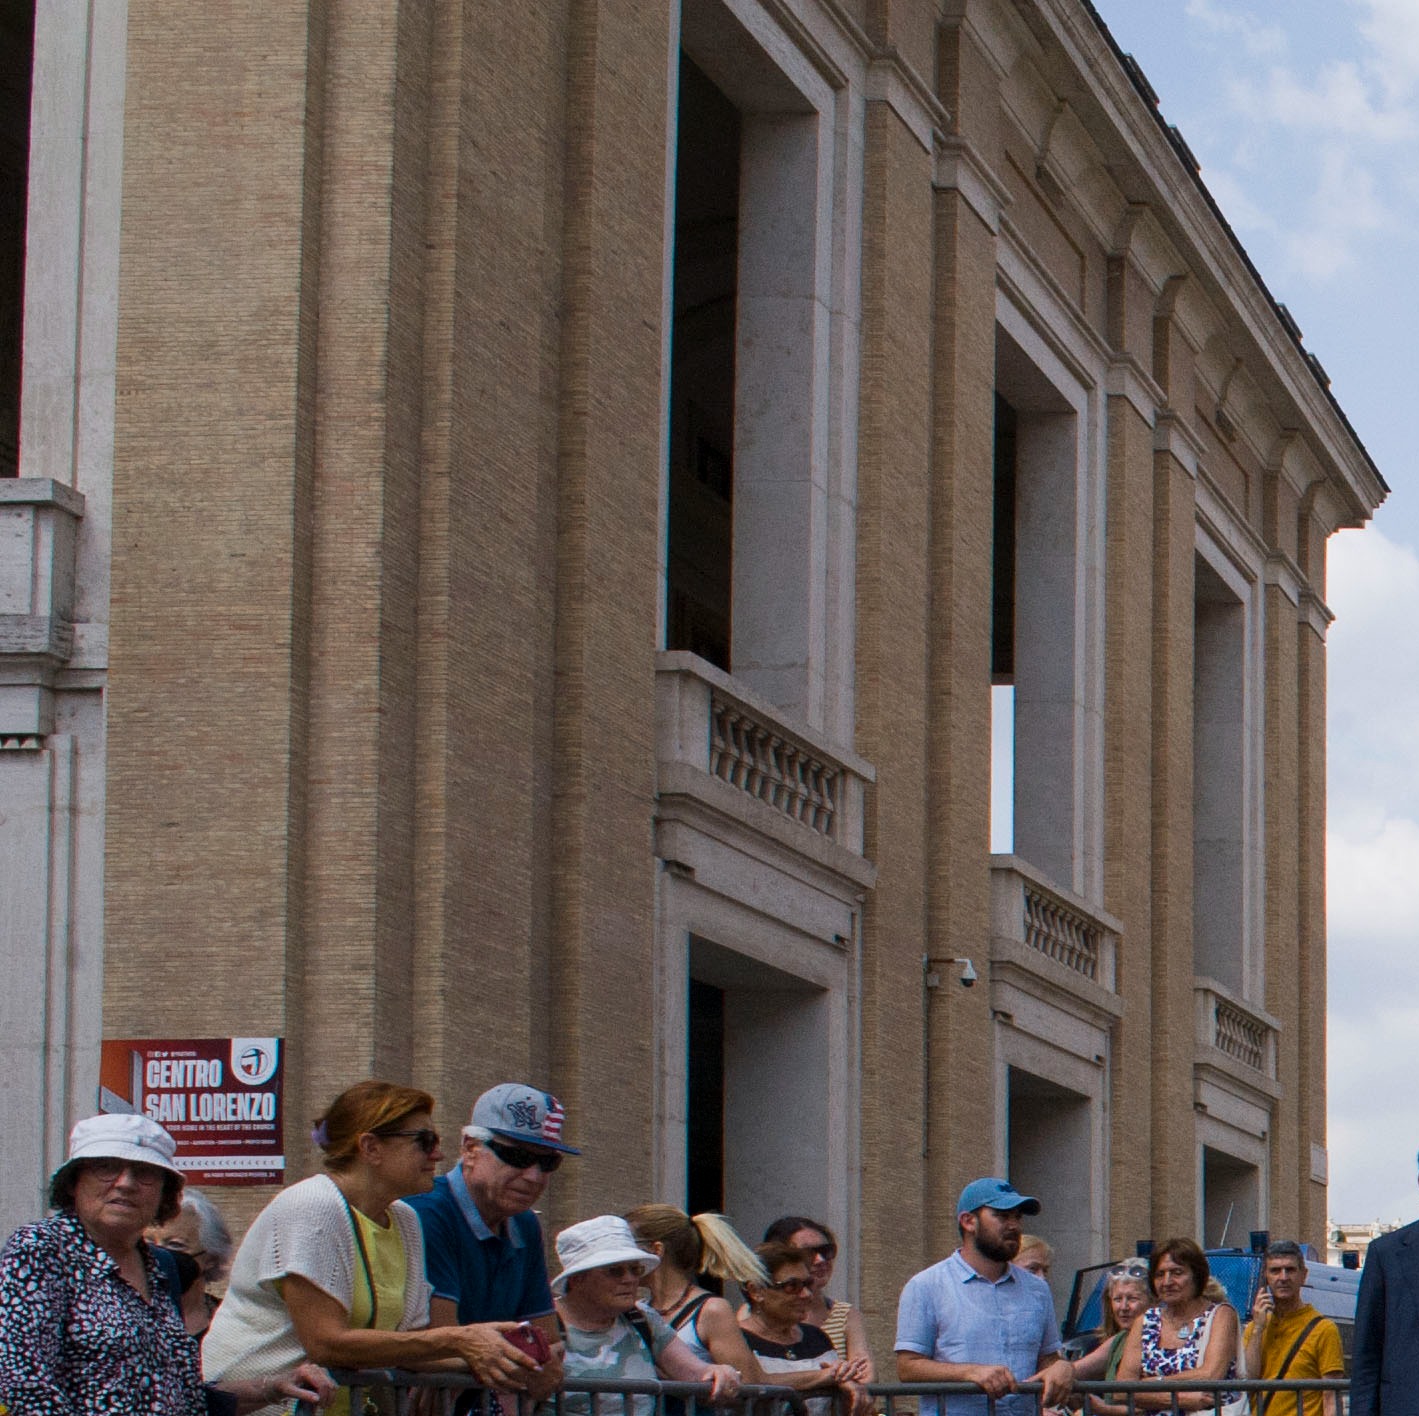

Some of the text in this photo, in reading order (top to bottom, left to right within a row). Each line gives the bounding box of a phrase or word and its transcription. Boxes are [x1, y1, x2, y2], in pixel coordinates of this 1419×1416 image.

[146, 1059, 222, 1088] CENTRO
[146, 1092, 276, 1122] SAN LORENZO
